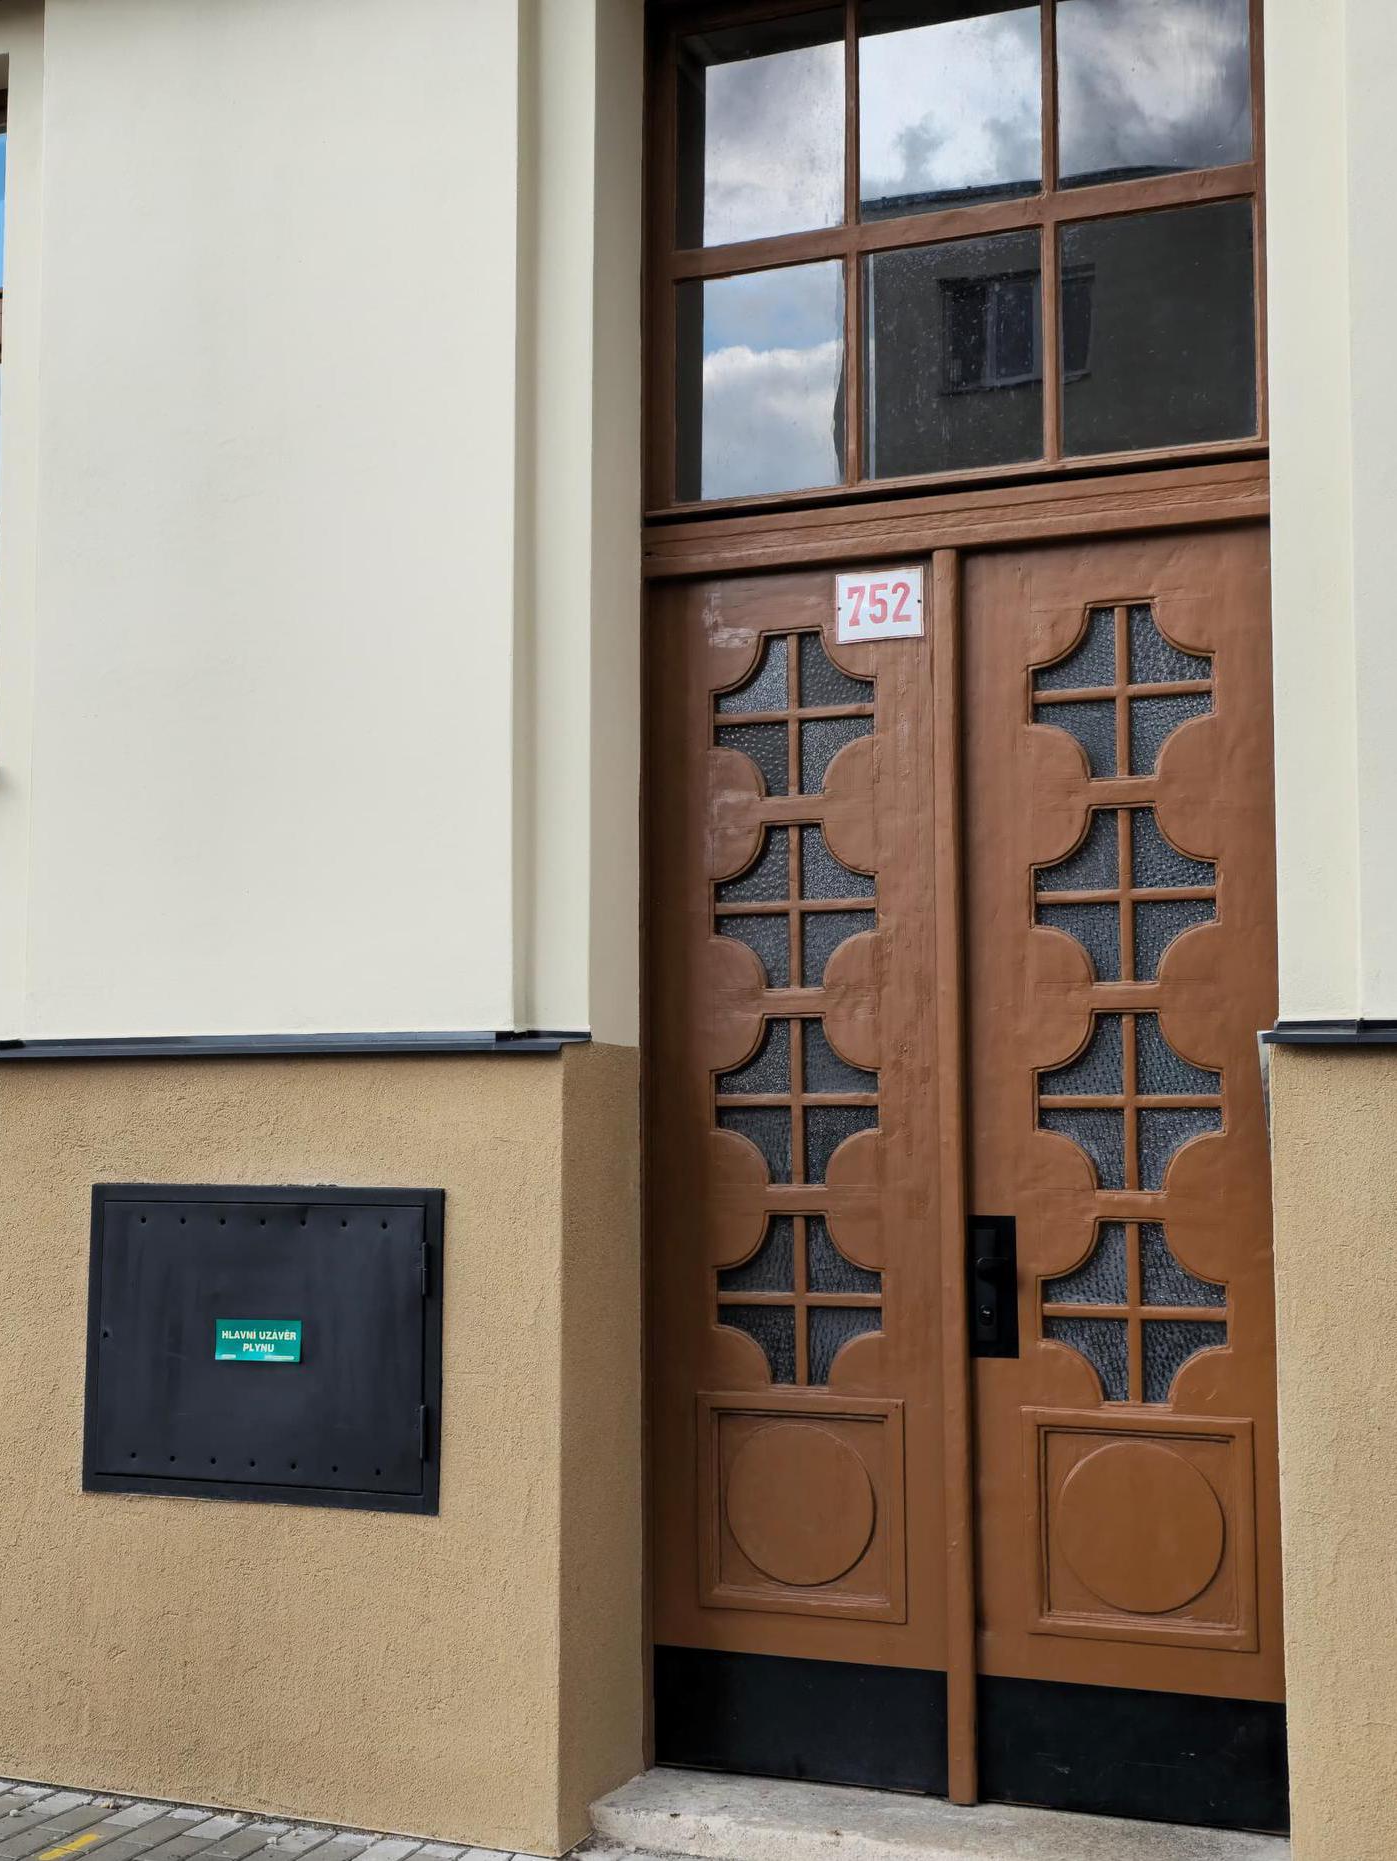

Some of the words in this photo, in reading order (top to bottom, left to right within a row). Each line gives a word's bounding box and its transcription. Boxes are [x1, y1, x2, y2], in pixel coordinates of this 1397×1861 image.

[847, 582, 912, 627] 752
[221, 1328, 256, 1340] HLAVNÍ
[259, 1329, 297, 1341] UZÁVĚR
[242, 1343, 275, 1353] PLYNU
